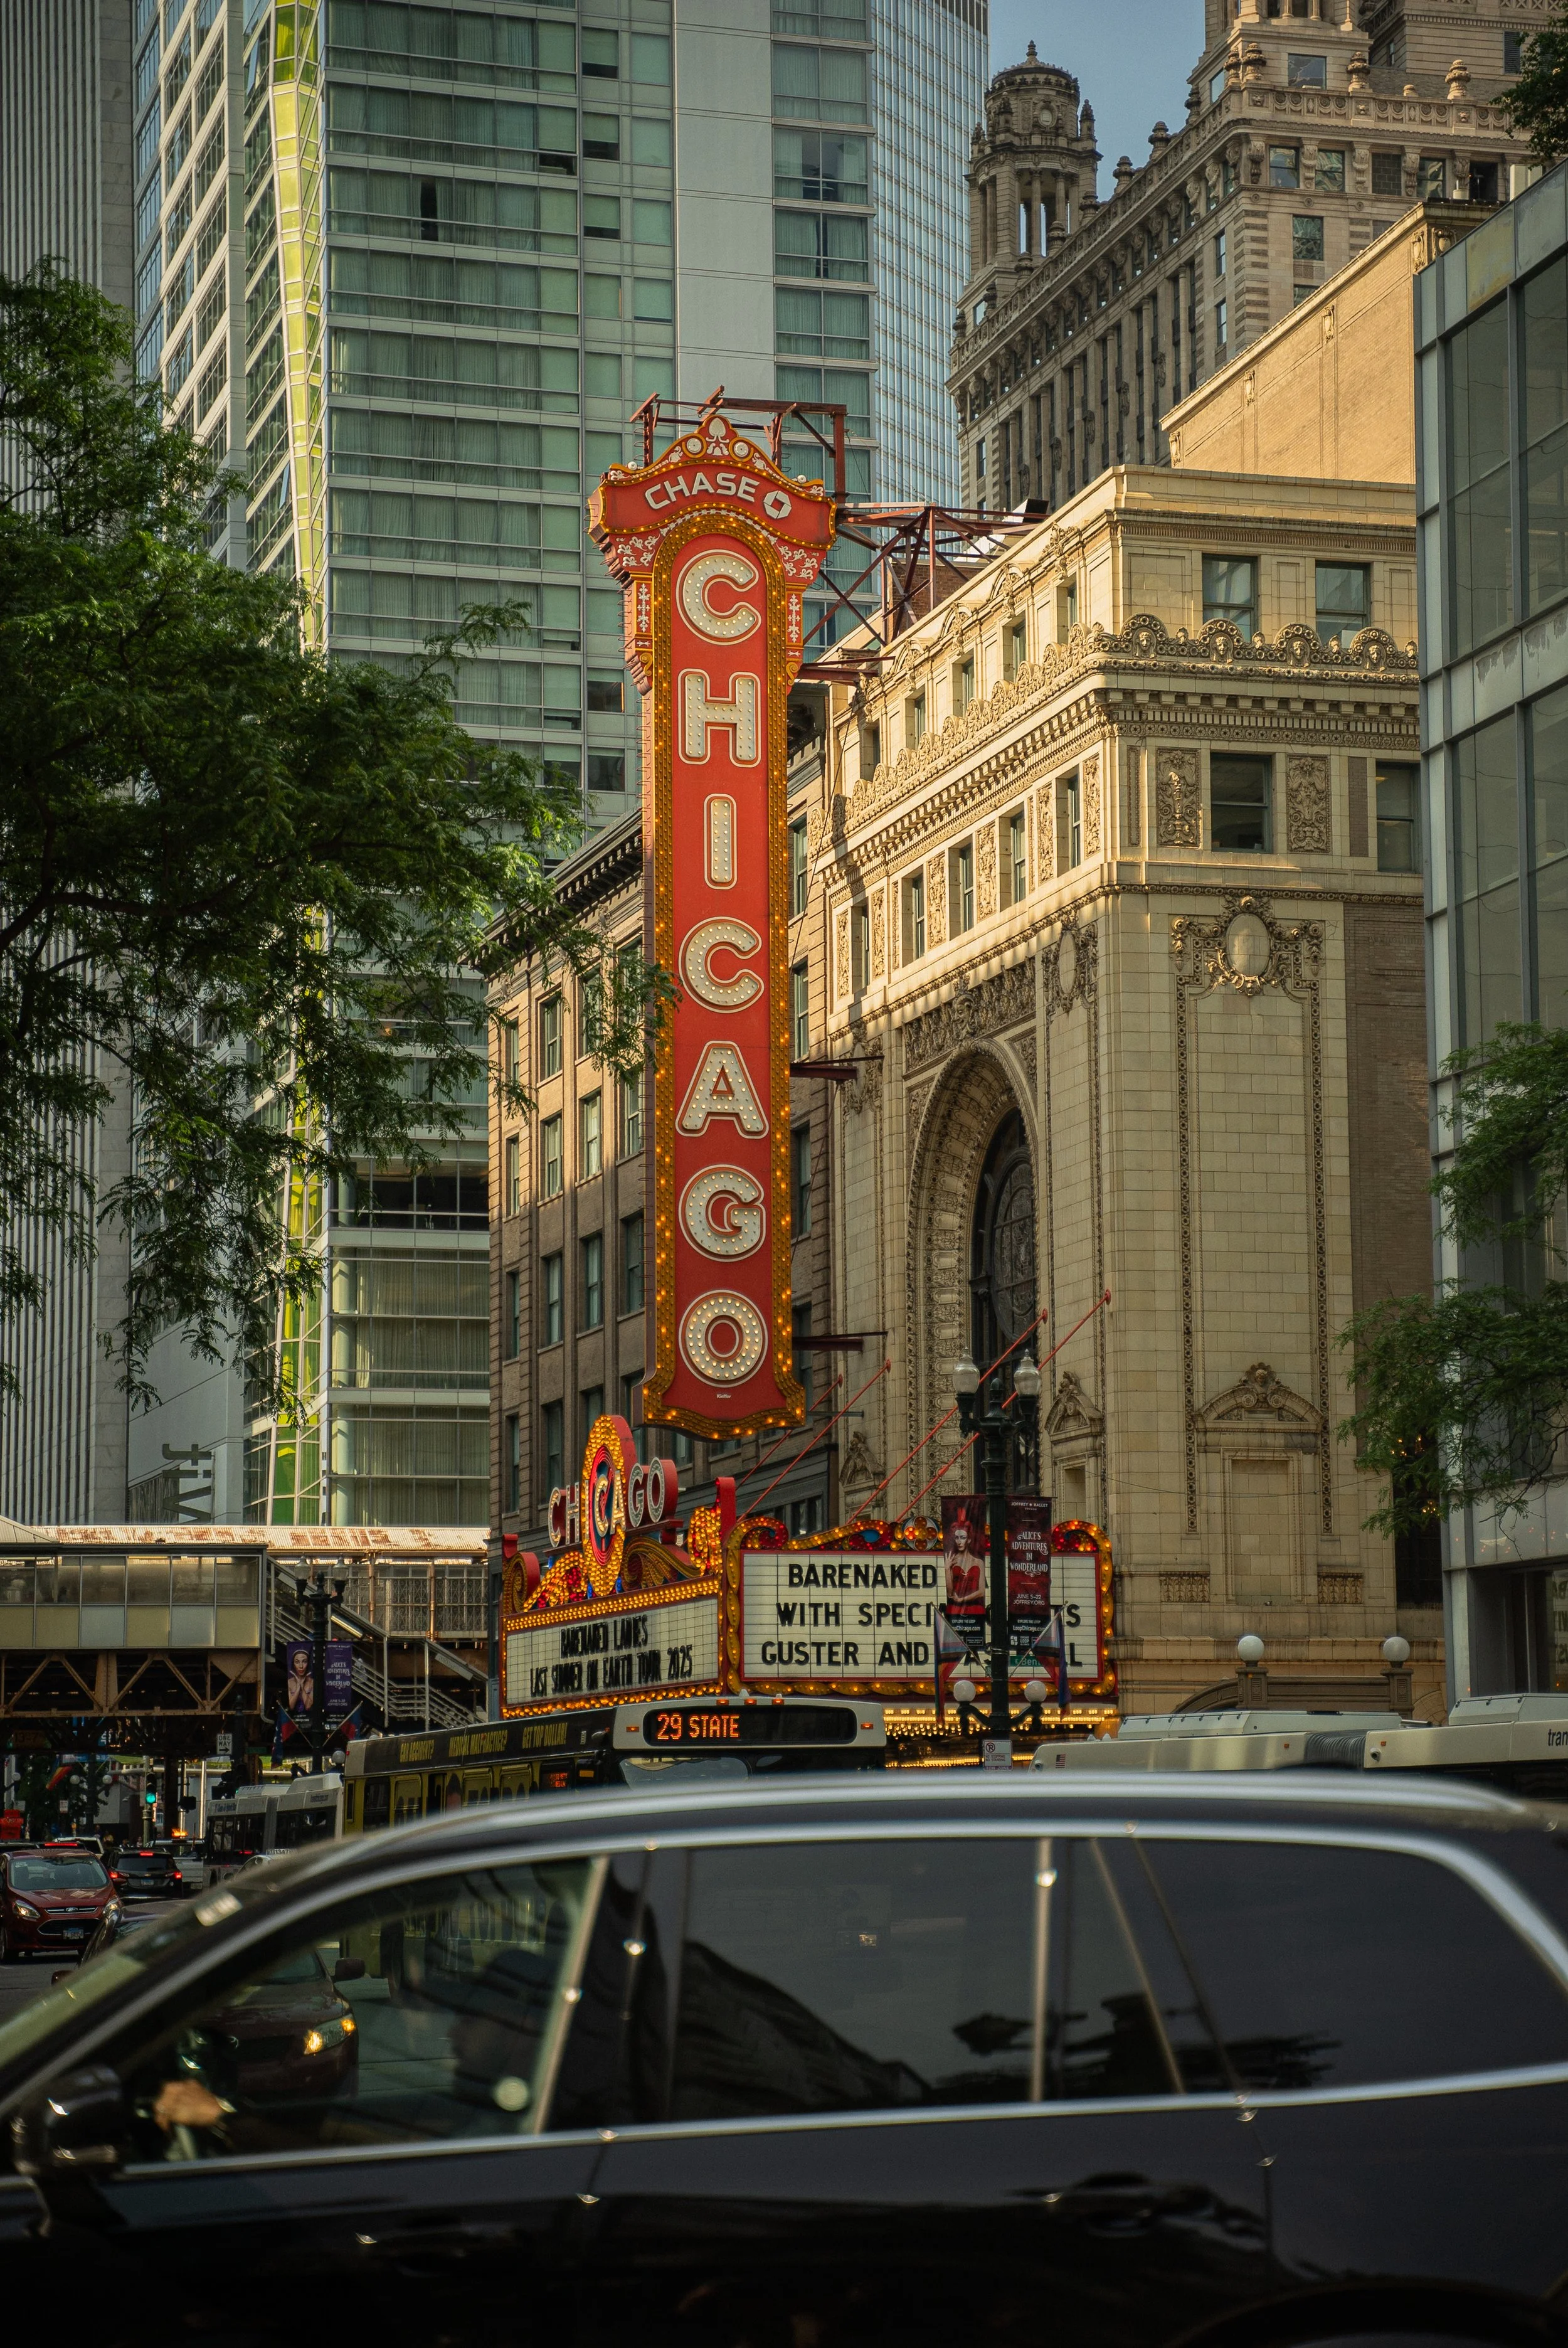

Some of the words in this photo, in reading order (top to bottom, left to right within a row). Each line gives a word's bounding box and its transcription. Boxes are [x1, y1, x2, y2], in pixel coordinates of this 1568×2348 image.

[645, 472, 760, 510] CHASE
[676, 550, 769, 1388] CHICAGO
[548, 1457, 665, 1548] CHICAGO
[1012, 1543, 1049, 1555] ADVENTURES
[1017, 1532, 1041, 1540] ALICE'S
[1010, 1563, 1048, 1574] WONDERLAND
[1026, 1553, 1032, 1561] IN
[788, 1563, 938, 1589] BARENAKED
[776, 1603, 840, 1627] WITH
[859, 1603, 946, 1628] SPECI
[613, 1614, 648, 1650] LADIES
[761, 1642, 859, 1666] GUSTER
[879, 1642, 929, 1666] AND
[530, 1666, 548, 1696] LAST
[586, 1659, 598, 1691] ON
[603, 1654, 633, 1688] EARTH
[637, 1650, 662, 1684] TOUR
[667, 1644, 692, 1681] 2025
[657, 1714, 682, 1740] 29
[689, 1716, 739, 1738] STATE
[400, 1742, 410, 1763] CAR
[448, 1734, 470, 1756] MEDICAL
[470, 1729, 508, 1755] MALPRACTICE?
[522, 1726, 532, 1749] GET
[532, 1725, 544, 1748] TOP
[544, 1722, 568, 1746] DOLLAR!
